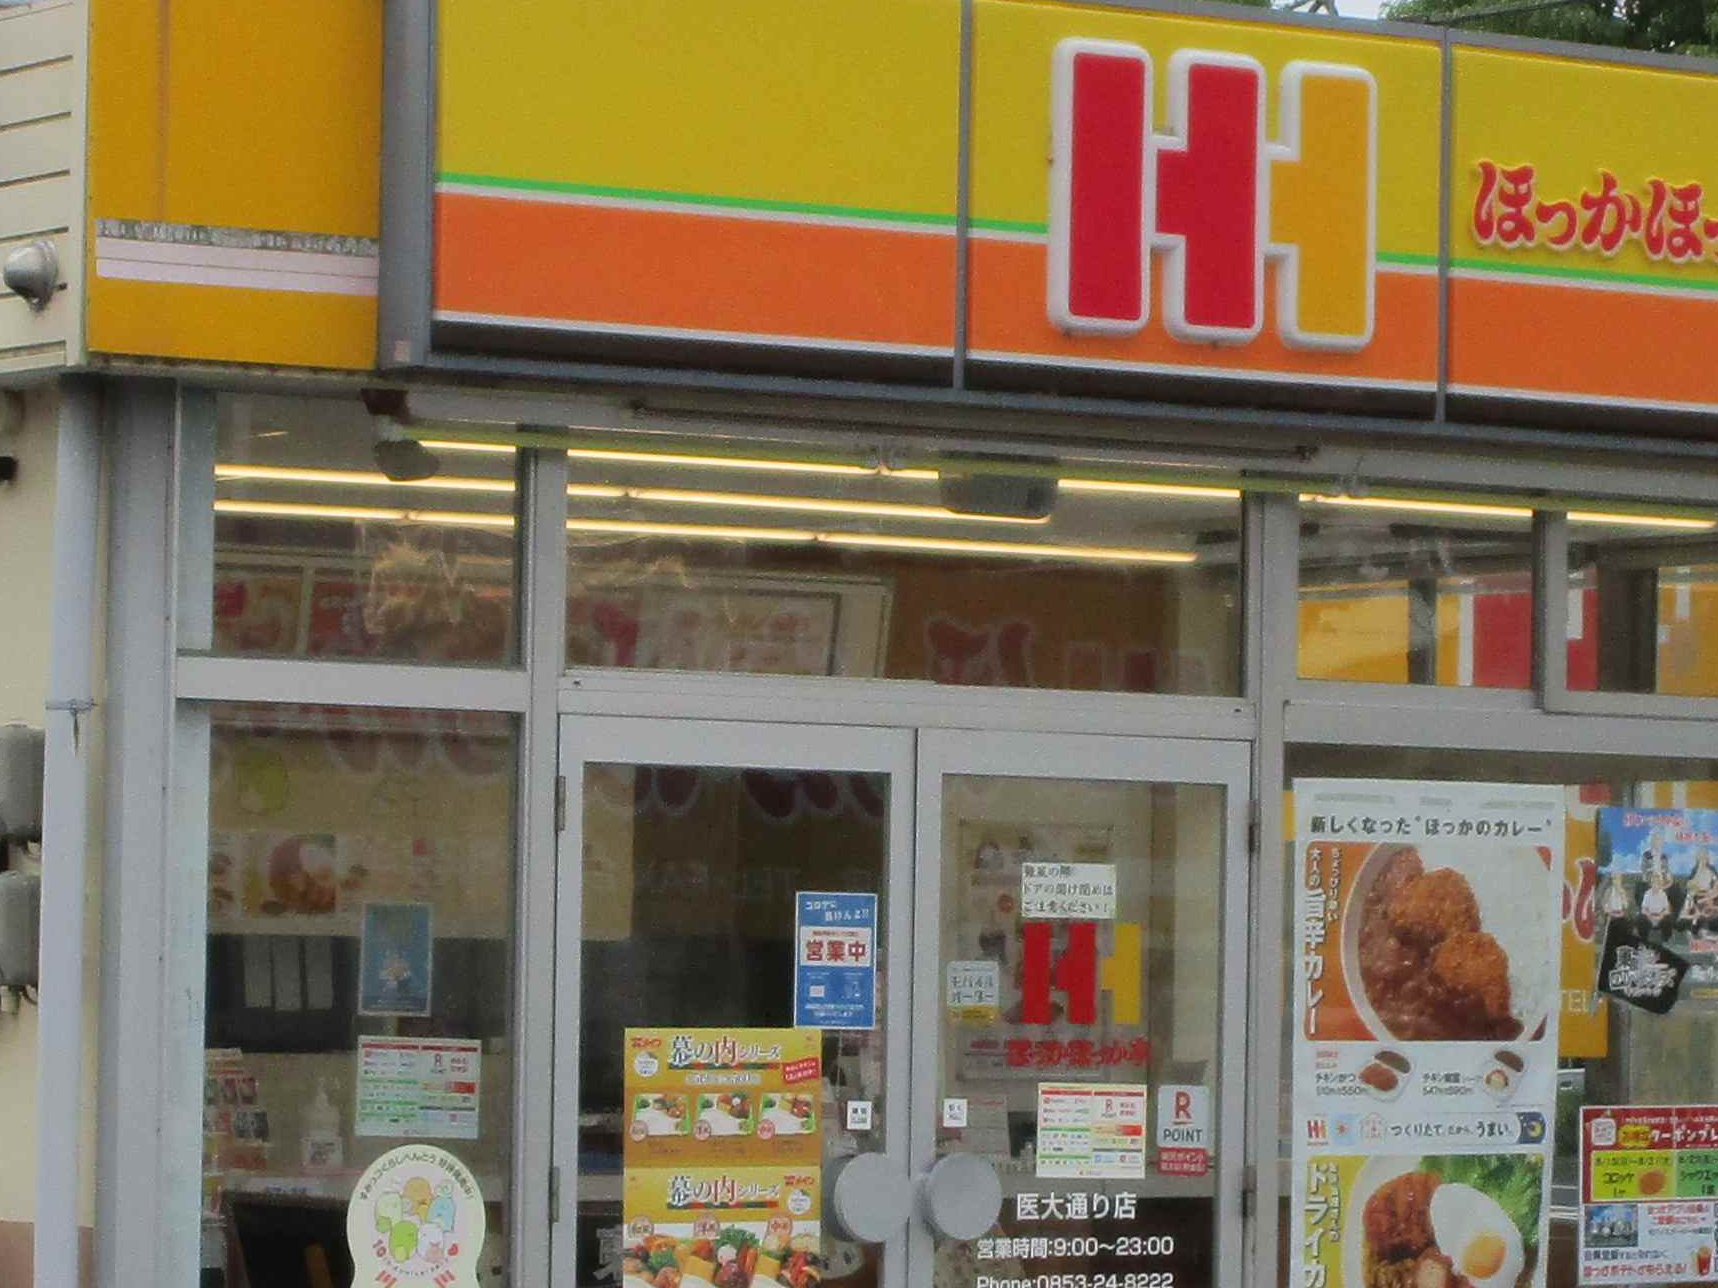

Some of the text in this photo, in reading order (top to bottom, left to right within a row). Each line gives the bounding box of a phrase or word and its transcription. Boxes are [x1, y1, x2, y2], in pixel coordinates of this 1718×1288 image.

[806, 939, 867, 963] 営業中
[1173, 1091, 1192, 1120] R
[1162, 1128, 1203, 1143] POINT
[1602, 1172, 1635, 1184] コロッケ
[1016, 1191, 1138, 1221] 医大通り店
